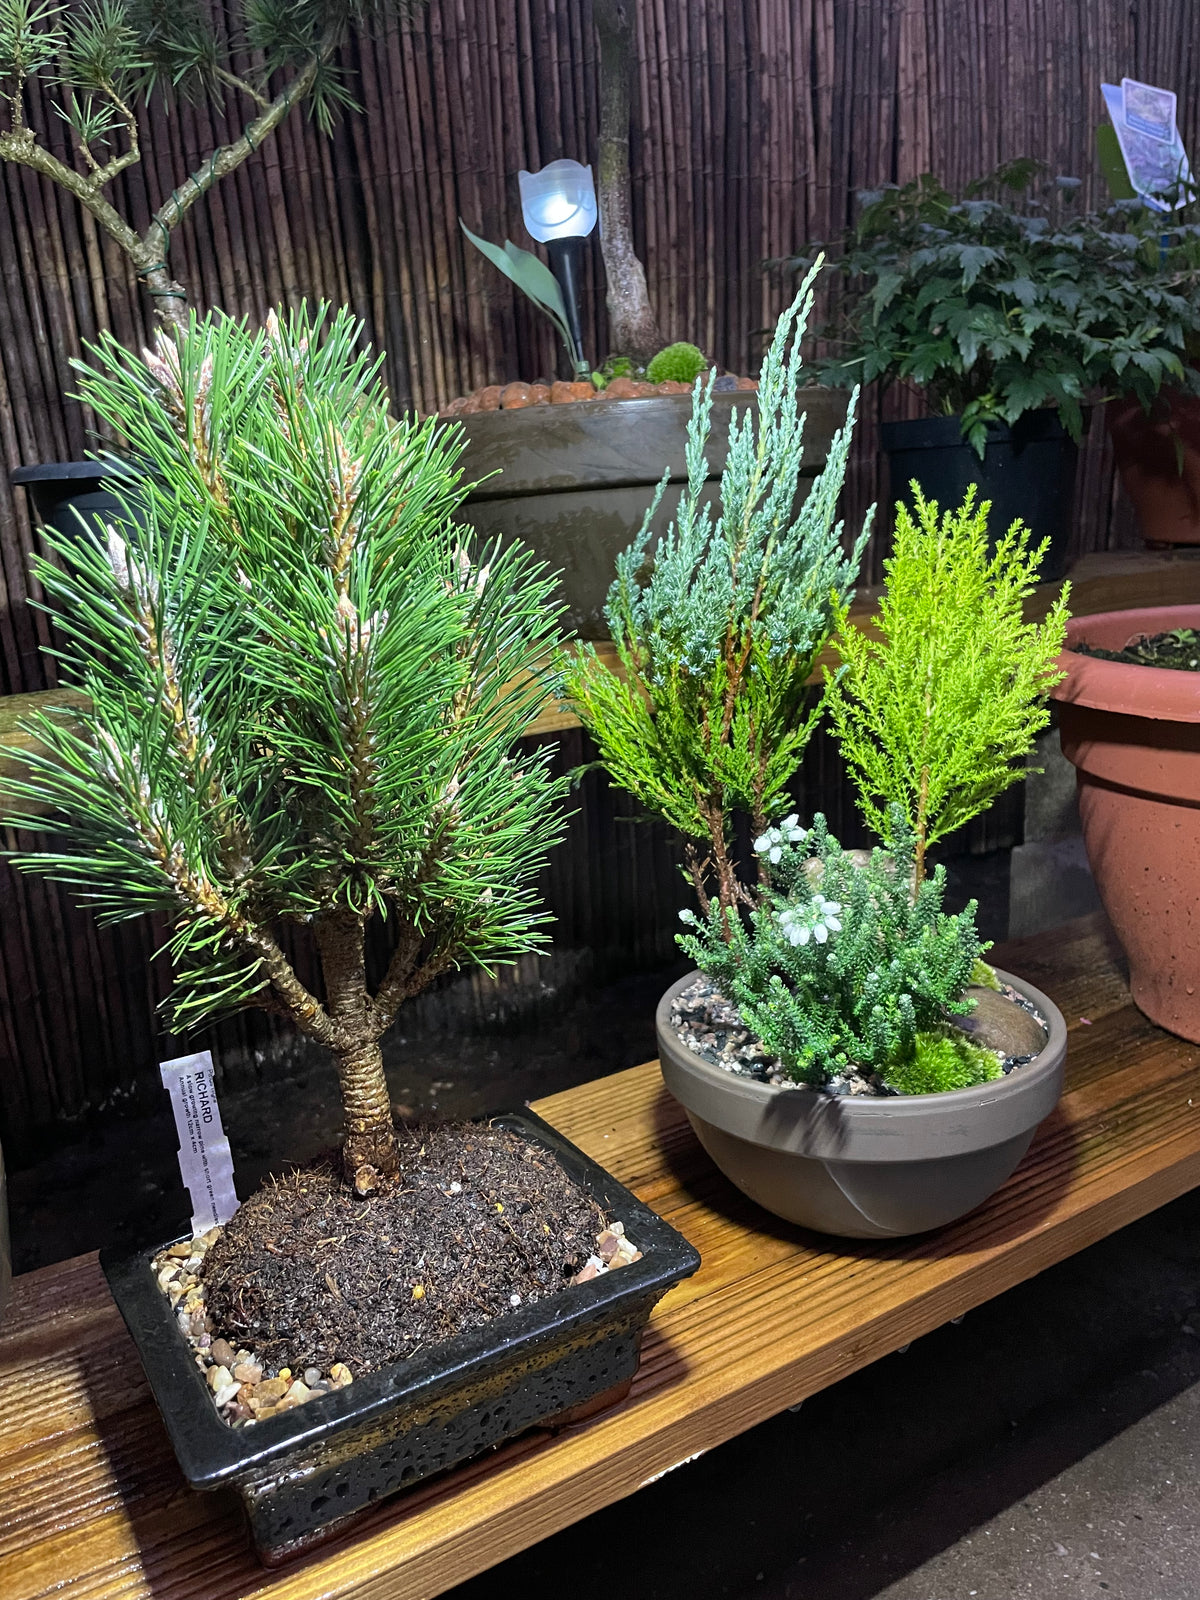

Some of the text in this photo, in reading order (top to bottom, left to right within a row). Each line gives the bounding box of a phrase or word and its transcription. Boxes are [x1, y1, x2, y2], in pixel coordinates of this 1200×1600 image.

[179, 1076, 187, 1096] Annual
[189, 1094, 198, 1118] growing
[194, 1071, 213, 1124] RICHARD
[182, 1098, 191, 1118] growth
[204, 1167, 212, 1183] short
[206, 1184, 214, 1200] green
